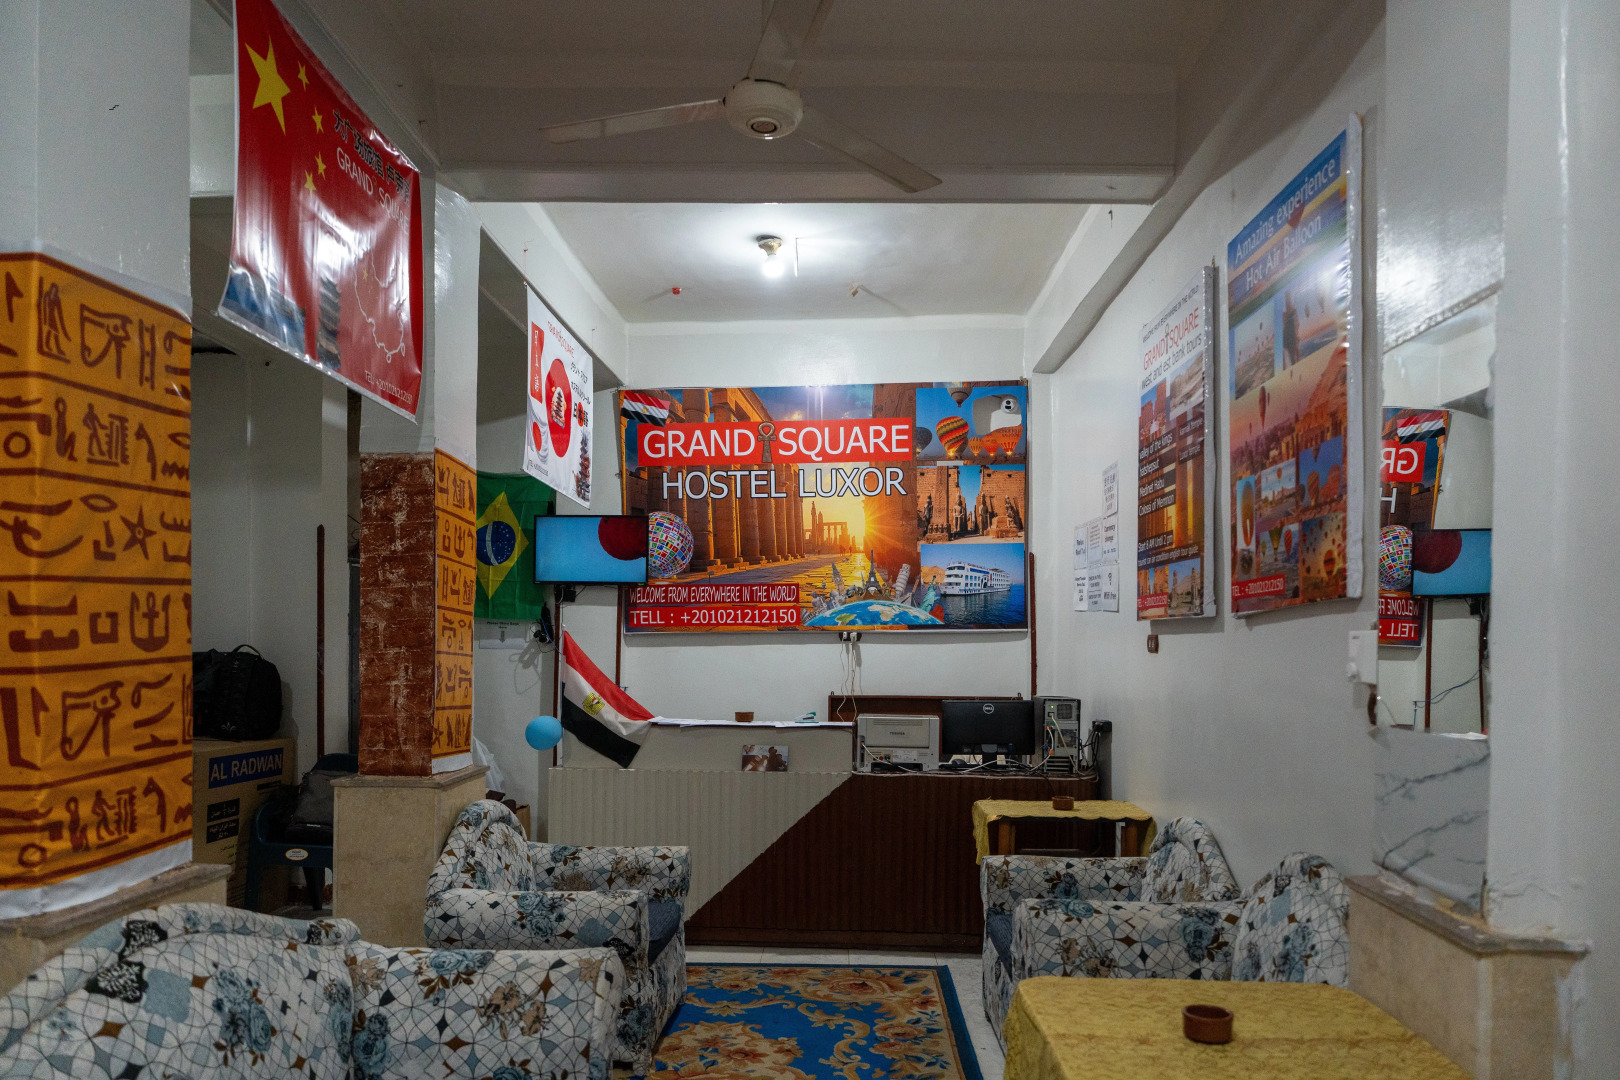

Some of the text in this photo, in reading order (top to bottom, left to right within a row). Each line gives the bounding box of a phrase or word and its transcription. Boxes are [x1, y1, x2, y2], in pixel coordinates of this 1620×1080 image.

[336, 148, 408, 234] GRAND SQUARE
[1235, 159, 1335, 264] Amazing experience
[1246, 216, 1322, 290] Hot Air Balloon
[1144, 307, 1200, 370] GRAND SQUARE
[1142, 333, 1202, 390] west and est bank tours
[644, 425, 909, 461] GRAND SQUARE
[1150, 444, 1154, 453] of
[1162, 433, 1173, 446] kings
[662, 467, 908, 500] HOSTEL LUXOR
[1140, 479, 1164, 497] Medinet Habu
[1152, 500, 1156, 510] of
[1157, 494, 1174, 508] Memnon
[1149, 539, 1154, 548] AM
[1188, 544, 1199, 556] guide
[630, 585, 797, 603] WELCOME FROM EVERYWHERE IN THE WORLD
[630, 609, 797, 624] TELL : +201021212150
[211, 754, 282, 782] AL RADWAN
